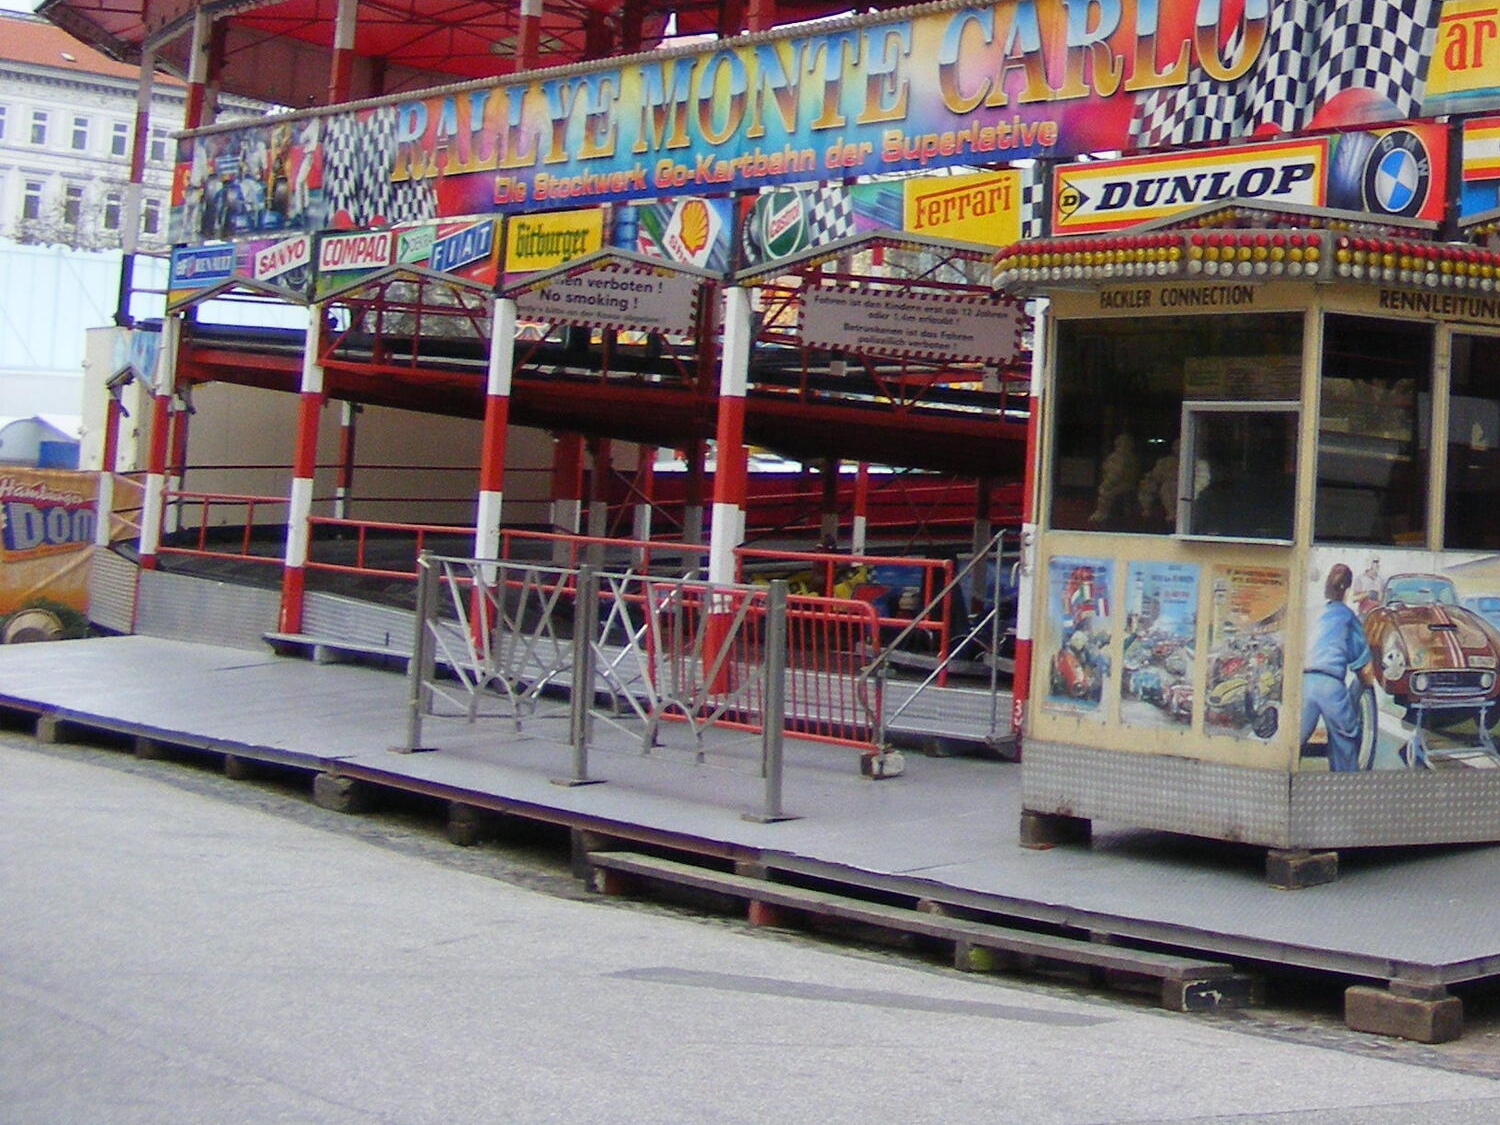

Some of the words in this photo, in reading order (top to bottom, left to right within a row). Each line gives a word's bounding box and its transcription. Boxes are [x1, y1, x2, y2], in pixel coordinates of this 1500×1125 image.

[392, 69, 624, 183] RALLYE
[631, 17, 912, 154] MONTE
[532, 164, 648, 202] Stockwerk
[654, 144, 816, 190] Go-Kartbahn
[825, 137, 872, 170] der
[881, 107, 1059, 162] Superlative
[1381, 130, 1430, 177] BMW
[914, 176, 1013, 231] Ferrari
[1095, 162, 1316, 211] DUNLOP
[258, 239, 306, 276] SANYO
[323, 234, 388, 267] COMPAQ
[433, 226, 490, 270] FIAT
[540, 290, 561, 303] No
[565, 294, 629, 312] smoking
[587, 278, 653, 293] verboten
[1100, 290, 1152, 309] FACKLER
[1160, 286, 1255, 307] CONNECTION
